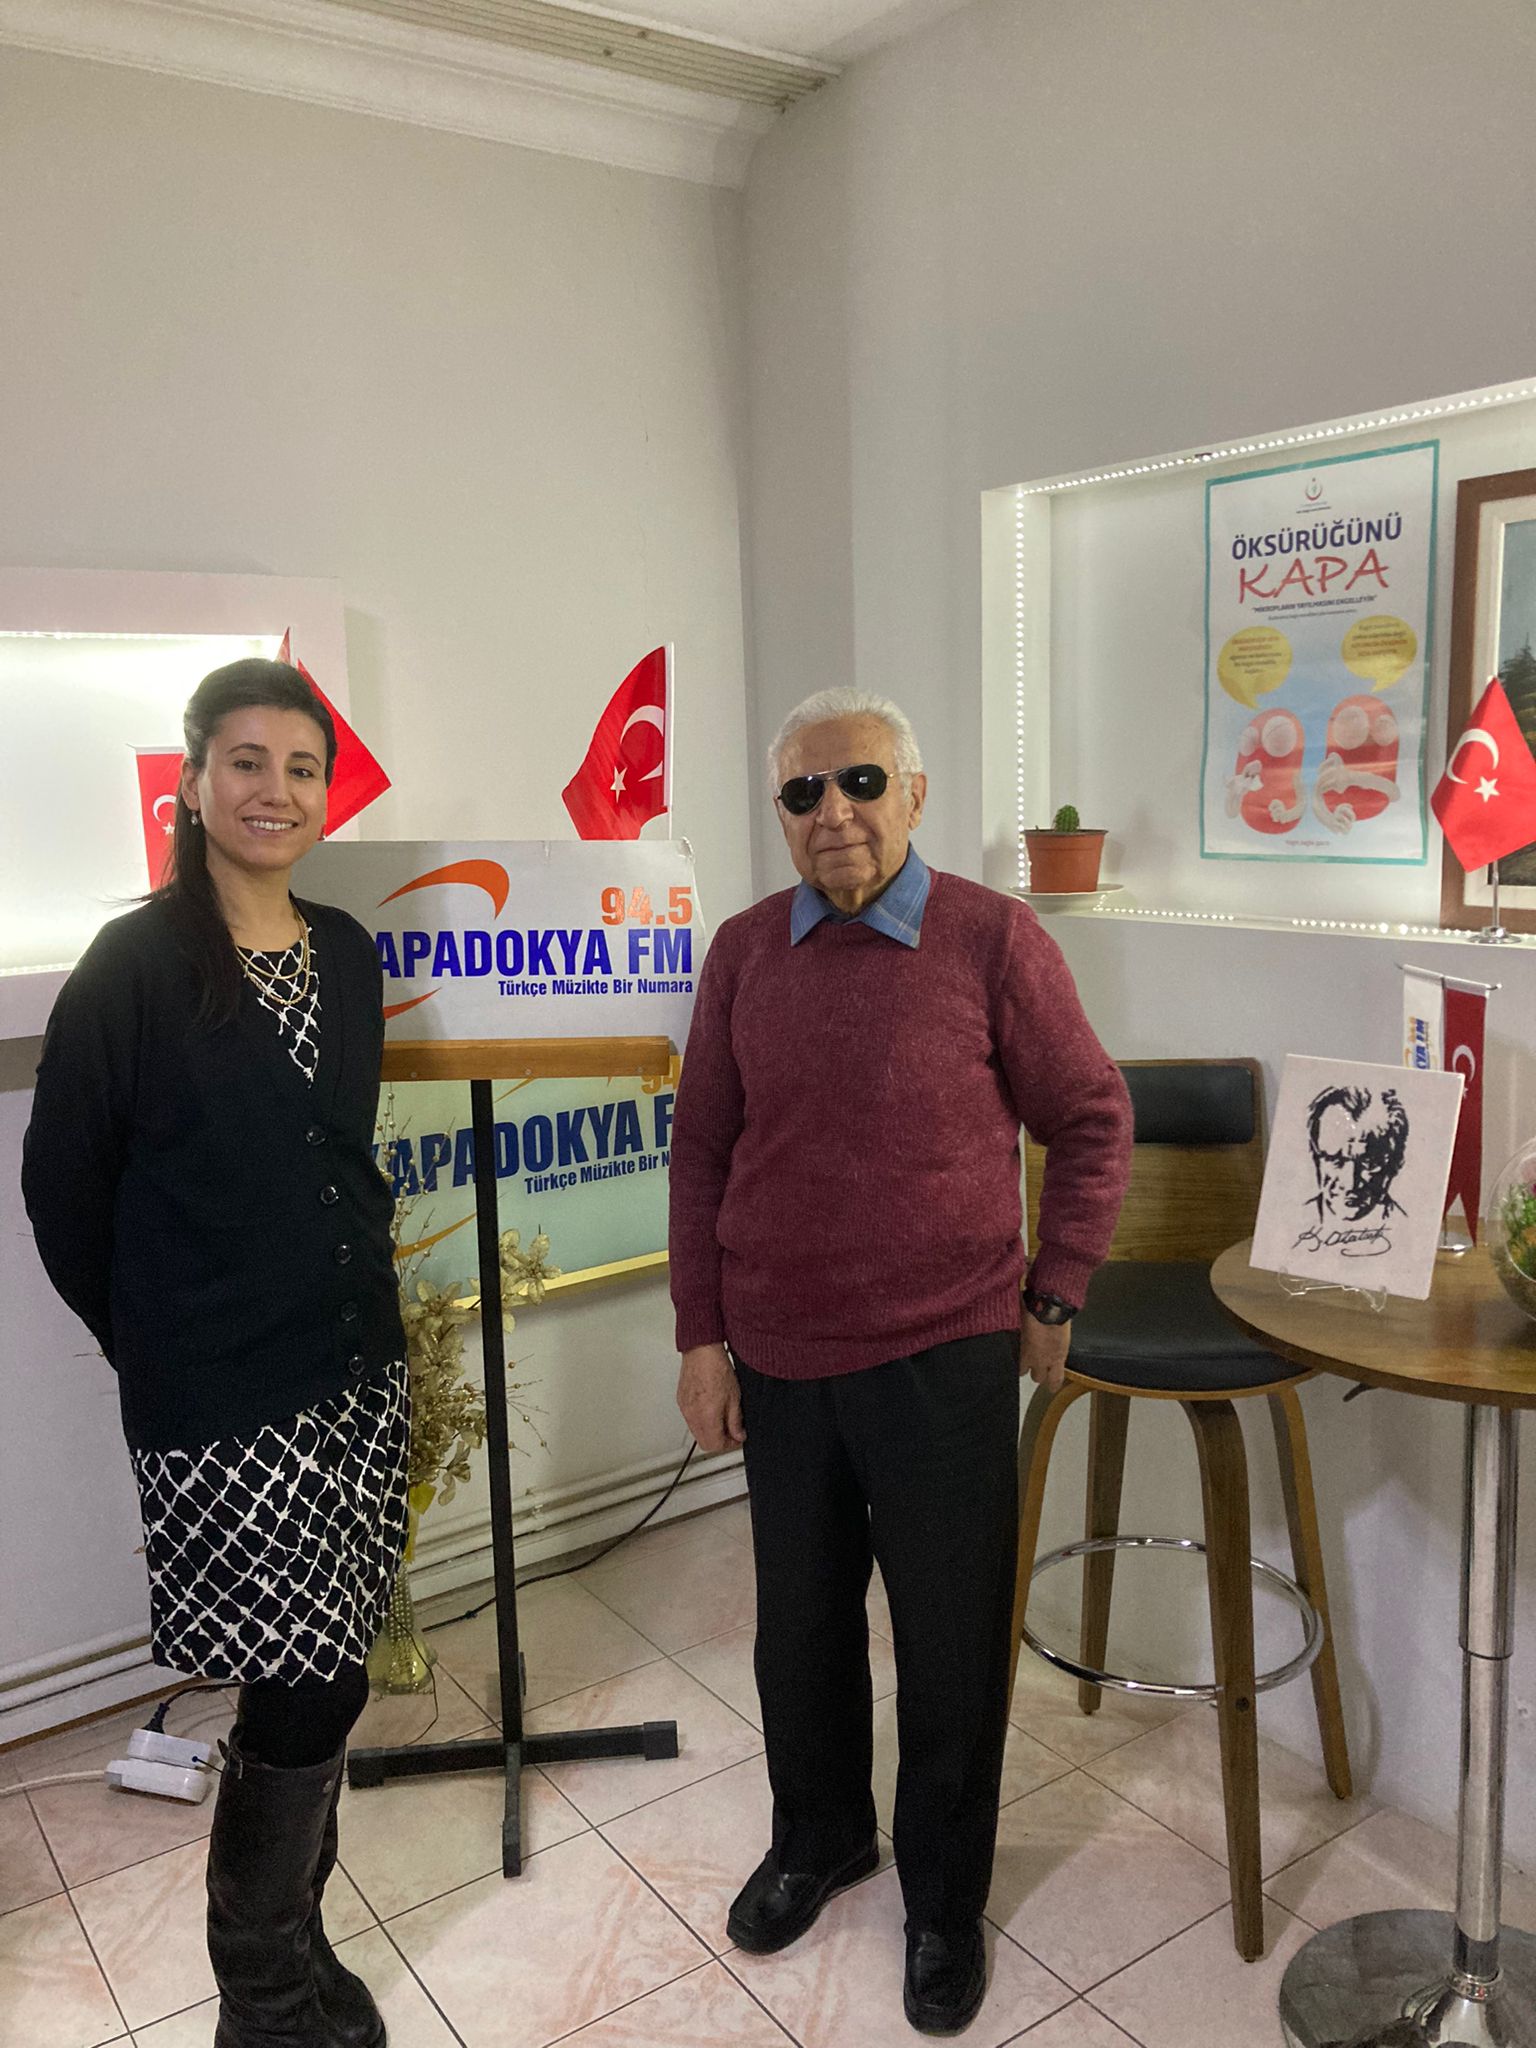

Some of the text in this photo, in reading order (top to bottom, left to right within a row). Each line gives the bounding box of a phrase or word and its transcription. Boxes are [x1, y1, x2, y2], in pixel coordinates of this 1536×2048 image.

[1232, 511, 1402, 560] ÖKSÜRÜĞÜNÜ
[1238, 548, 1389, 604] KAPA
[601, 886, 693, 926] 94.5
[375, 928, 692, 978] APADOKYA FM
[498, 978, 693, 998] Türkçe Müzikte Bir Numara
[371, 1094, 674, 1198] APADOKYA F
[524, 1172, 577, 1195] Türkçe
[580, 1161, 635, 1184] Müzikte
[638, 1155, 658, 1173] Bir
